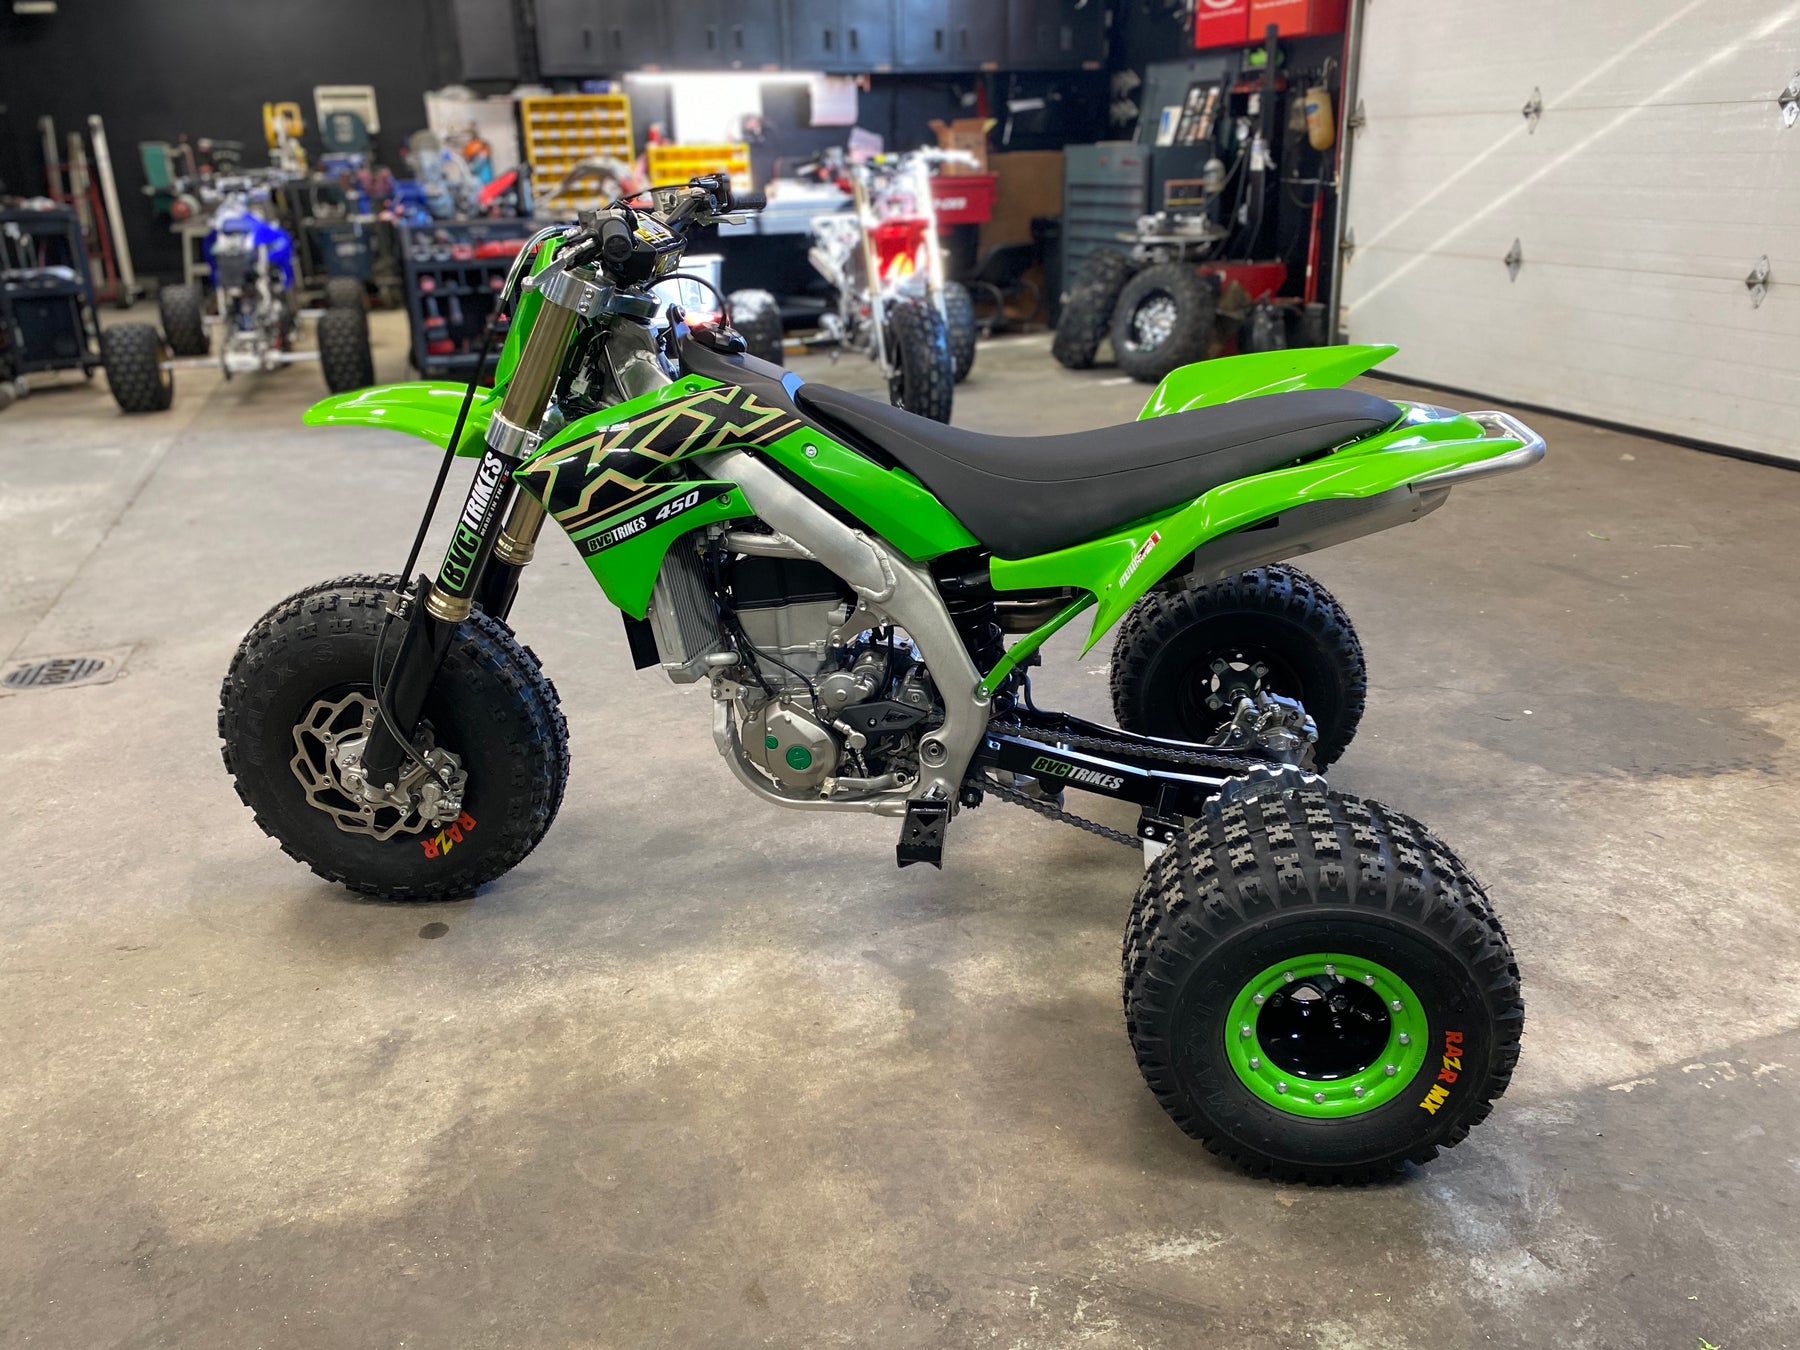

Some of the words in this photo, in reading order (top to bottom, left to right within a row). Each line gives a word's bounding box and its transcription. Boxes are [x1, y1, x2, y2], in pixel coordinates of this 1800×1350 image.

[441, 525, 481, 590] BVC
[461, 450, 504, 531] TRIKES
[480, 511, 493, 537] MADE
[489, 501, 498, 512] IN
[494, 484, 506, 501] THE
[655, 490, 700, 522] 450
[588, 533, 613, 552] BVC
[612, 516, 648, 543] TRIKES
[1032, 756, 1071, 777] BVC
[1067, 765, 1125, 790] TRIKES
[420, 809, 478, 860] RAZR
[1437, 1030, 1464, 1084] RAZR
[1418, 1083, 1451, 1116] MX
